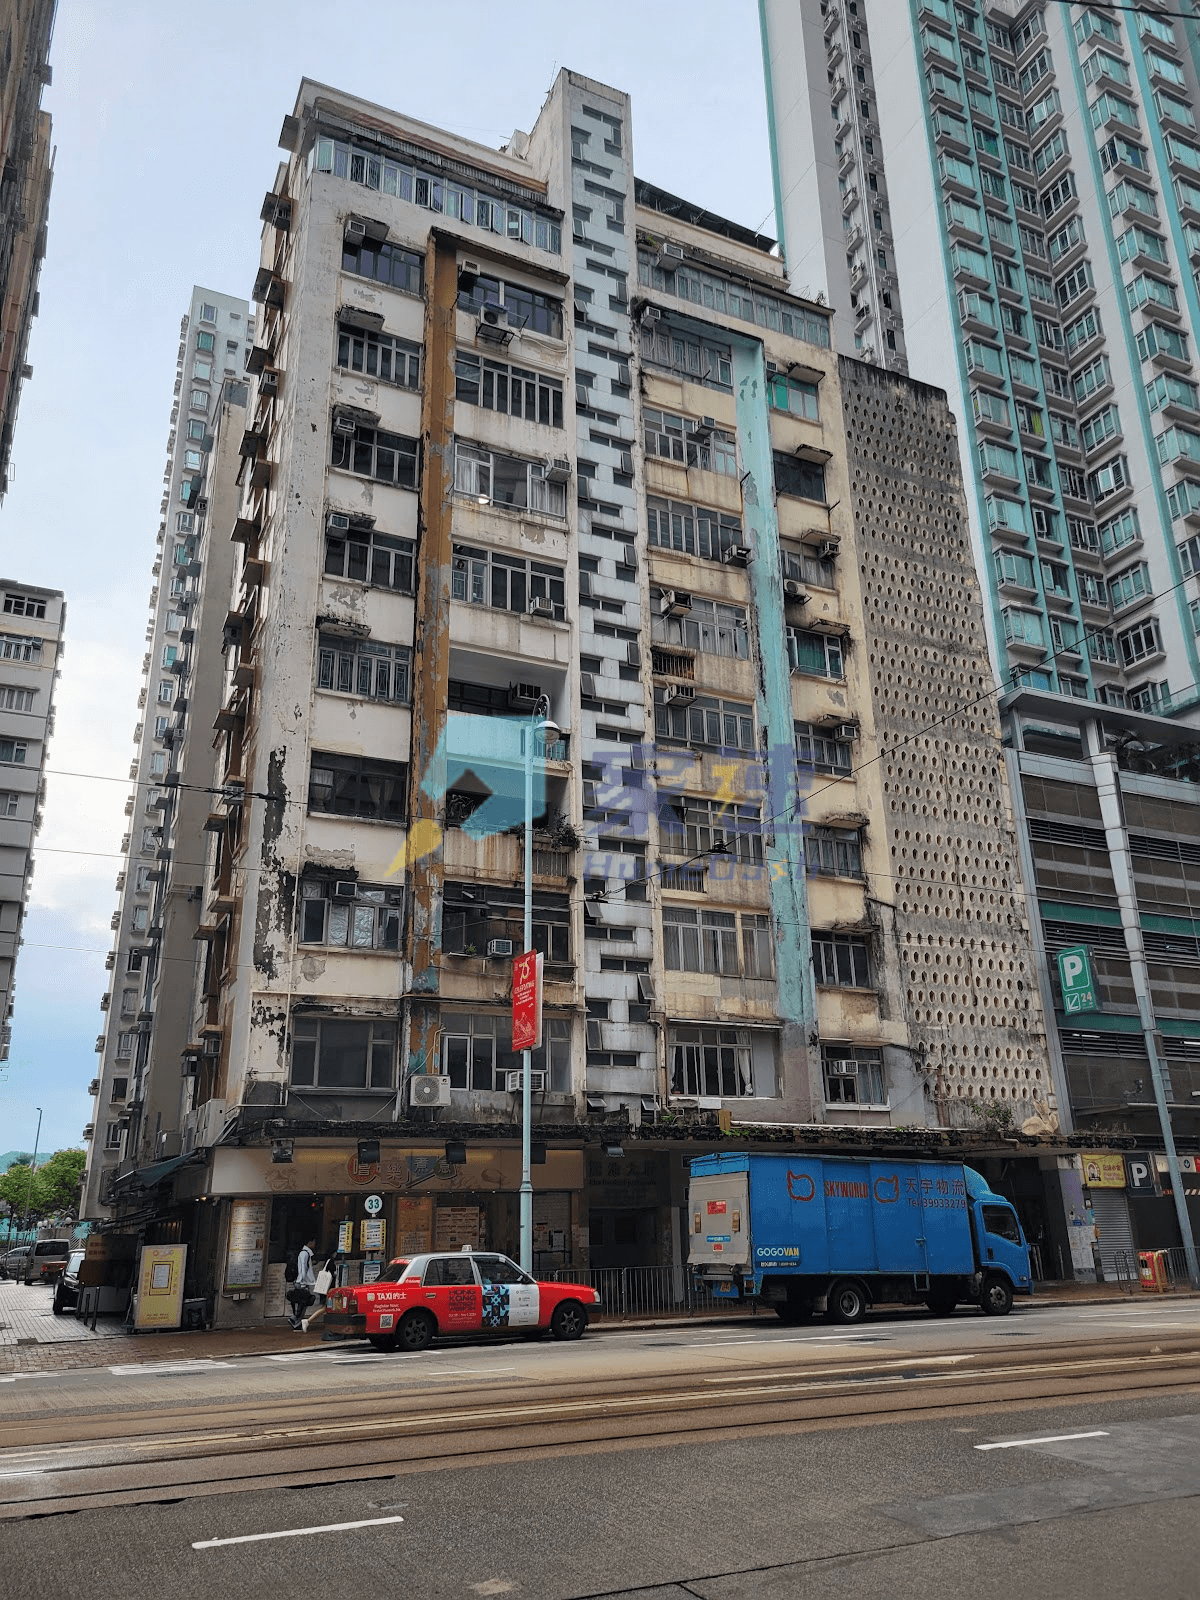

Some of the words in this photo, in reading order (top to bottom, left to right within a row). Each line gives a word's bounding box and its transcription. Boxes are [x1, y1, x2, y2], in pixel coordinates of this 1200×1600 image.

[1063, 955, 1083, 987] P
[1080, 991, 1093, 1003] 24
[1131, 1162, 1148, 1187] P
[823, 1180, 869, 1198] SKYWORLD
[904, 1177, 965, 1195] 天宇物流
[367, 1198, 380, 1210] 33
[757, 1247, 800, 1257] GOGOVAN
